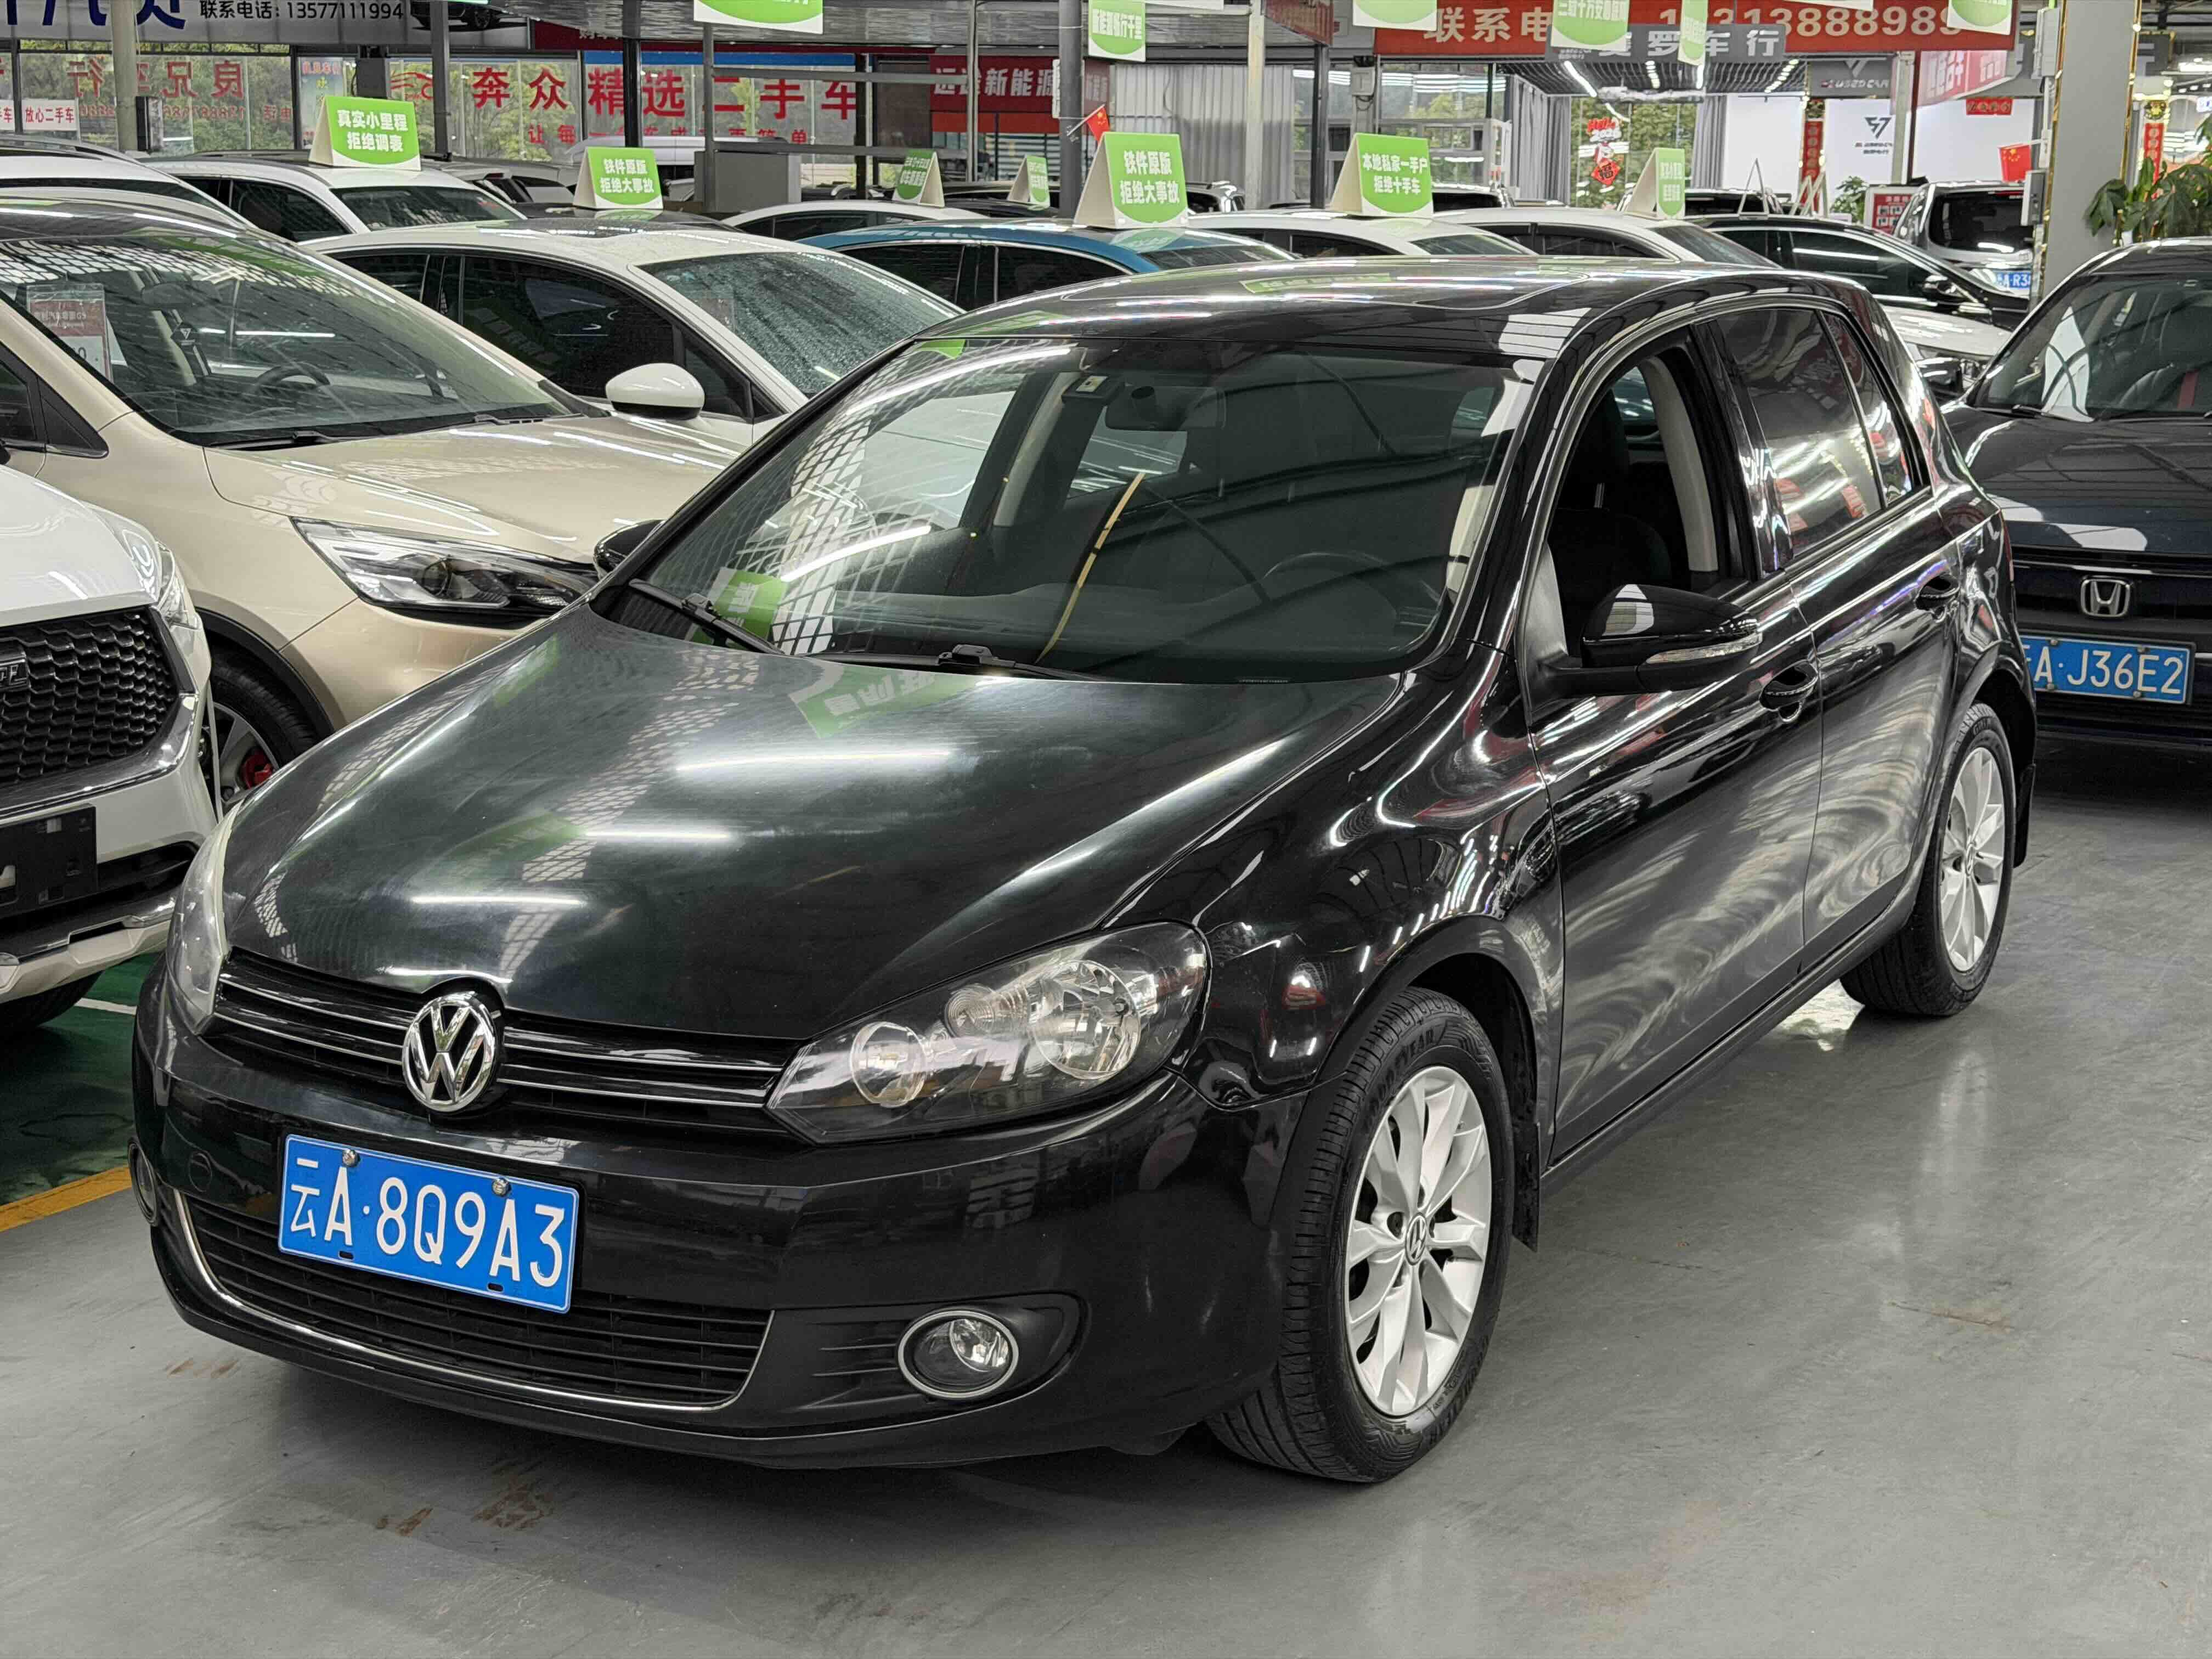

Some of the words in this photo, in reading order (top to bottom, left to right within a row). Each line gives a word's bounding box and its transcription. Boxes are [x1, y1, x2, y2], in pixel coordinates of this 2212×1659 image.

[286, 2, 403, 19] 13577111994
[25, 107, 75, 123] 放心二手车
[337, 110, 408, 131] 真实小里程
[347, 132, 404, 152] 拒绝调表
[1124, 150, 1172, 175] 铁件原版
[600, 177, 654, 194] 拒绝大事故
[1120, 180, 1180, 205] 拒绝大事故
[2023, 644, 2183, 695] A·J36E2
[290, 1158, 565, 1288] 云A·8Q9A3
